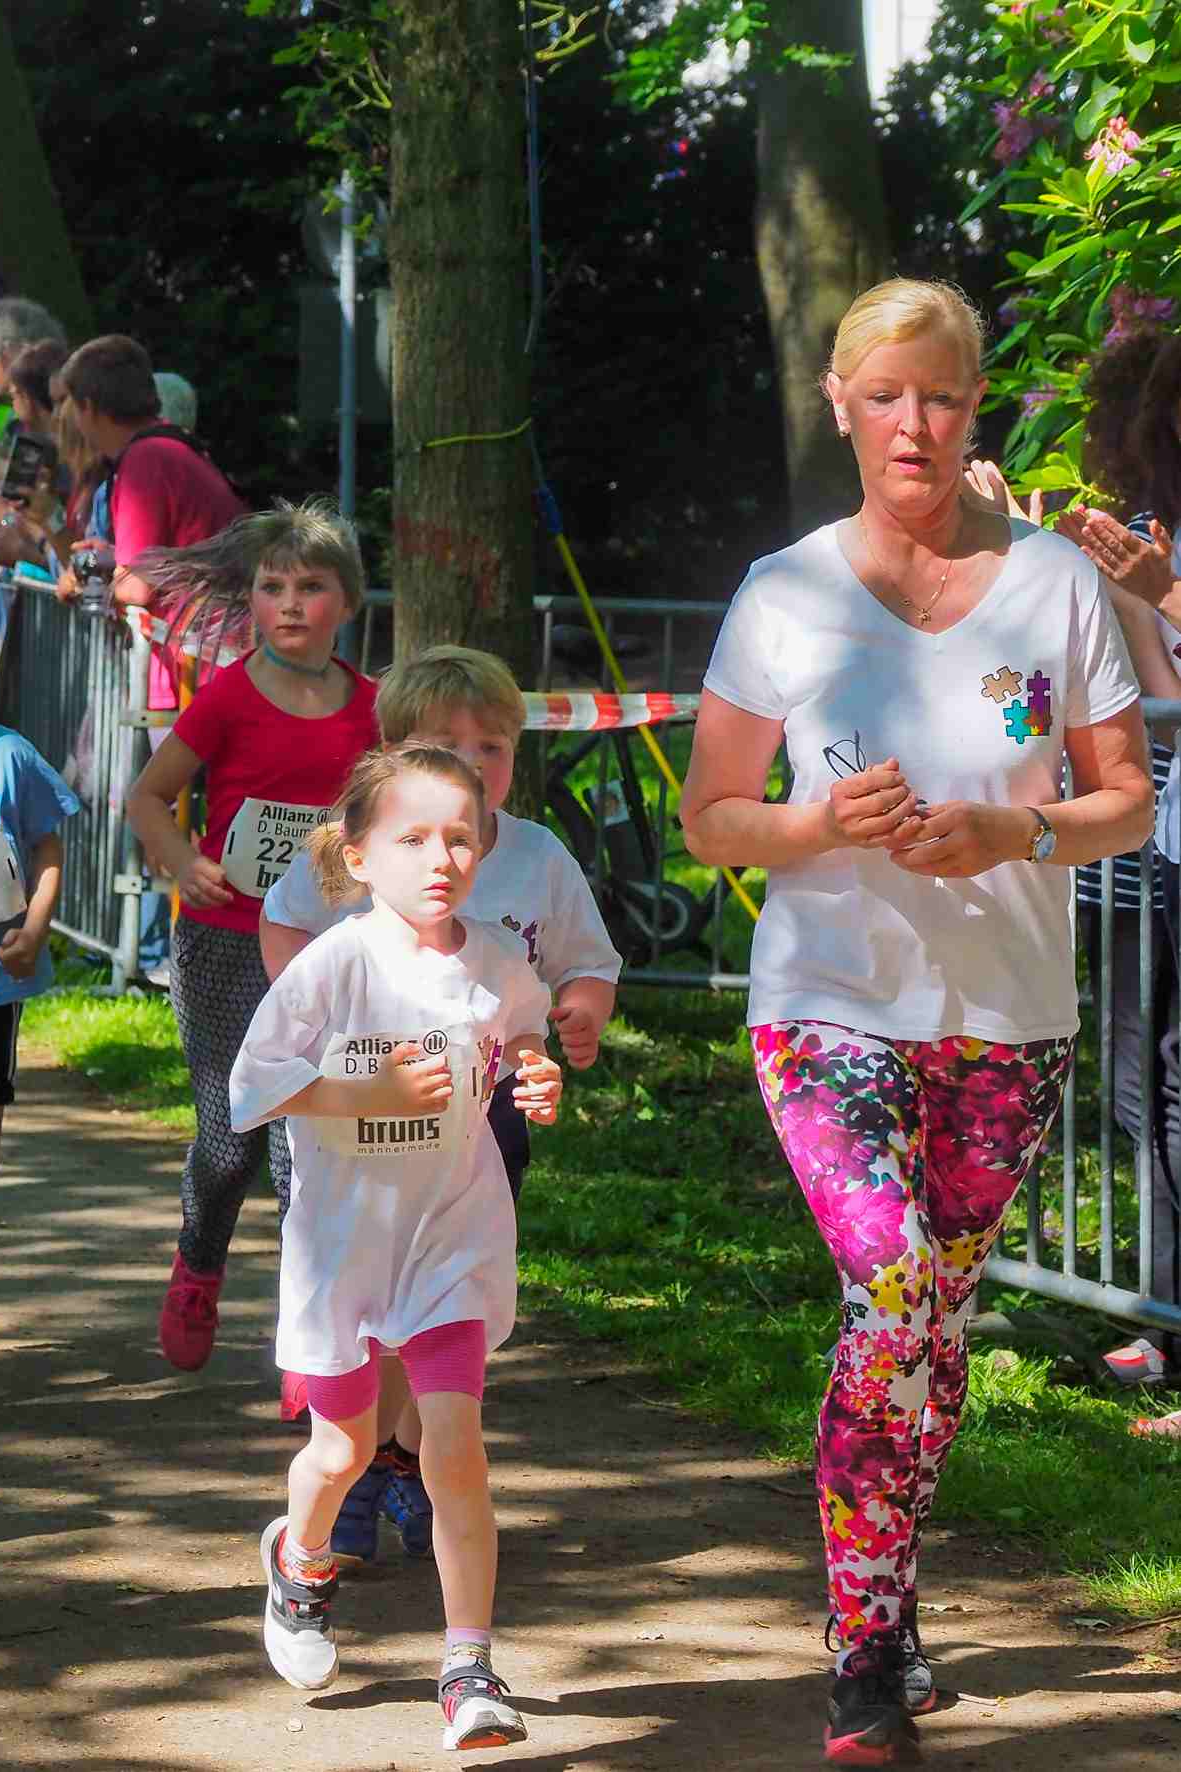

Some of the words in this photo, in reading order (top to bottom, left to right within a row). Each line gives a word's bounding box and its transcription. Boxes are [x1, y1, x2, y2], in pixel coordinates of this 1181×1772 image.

[259, 804, 315, 824] Allianz
[257, 820, 272, 835] D.
[274, 822, 308, 839] Baum
[256, 837, 294, 865] 22
[345, 1057, 363, 1075] D.
[357, 1117, 441, 1145] bruns
